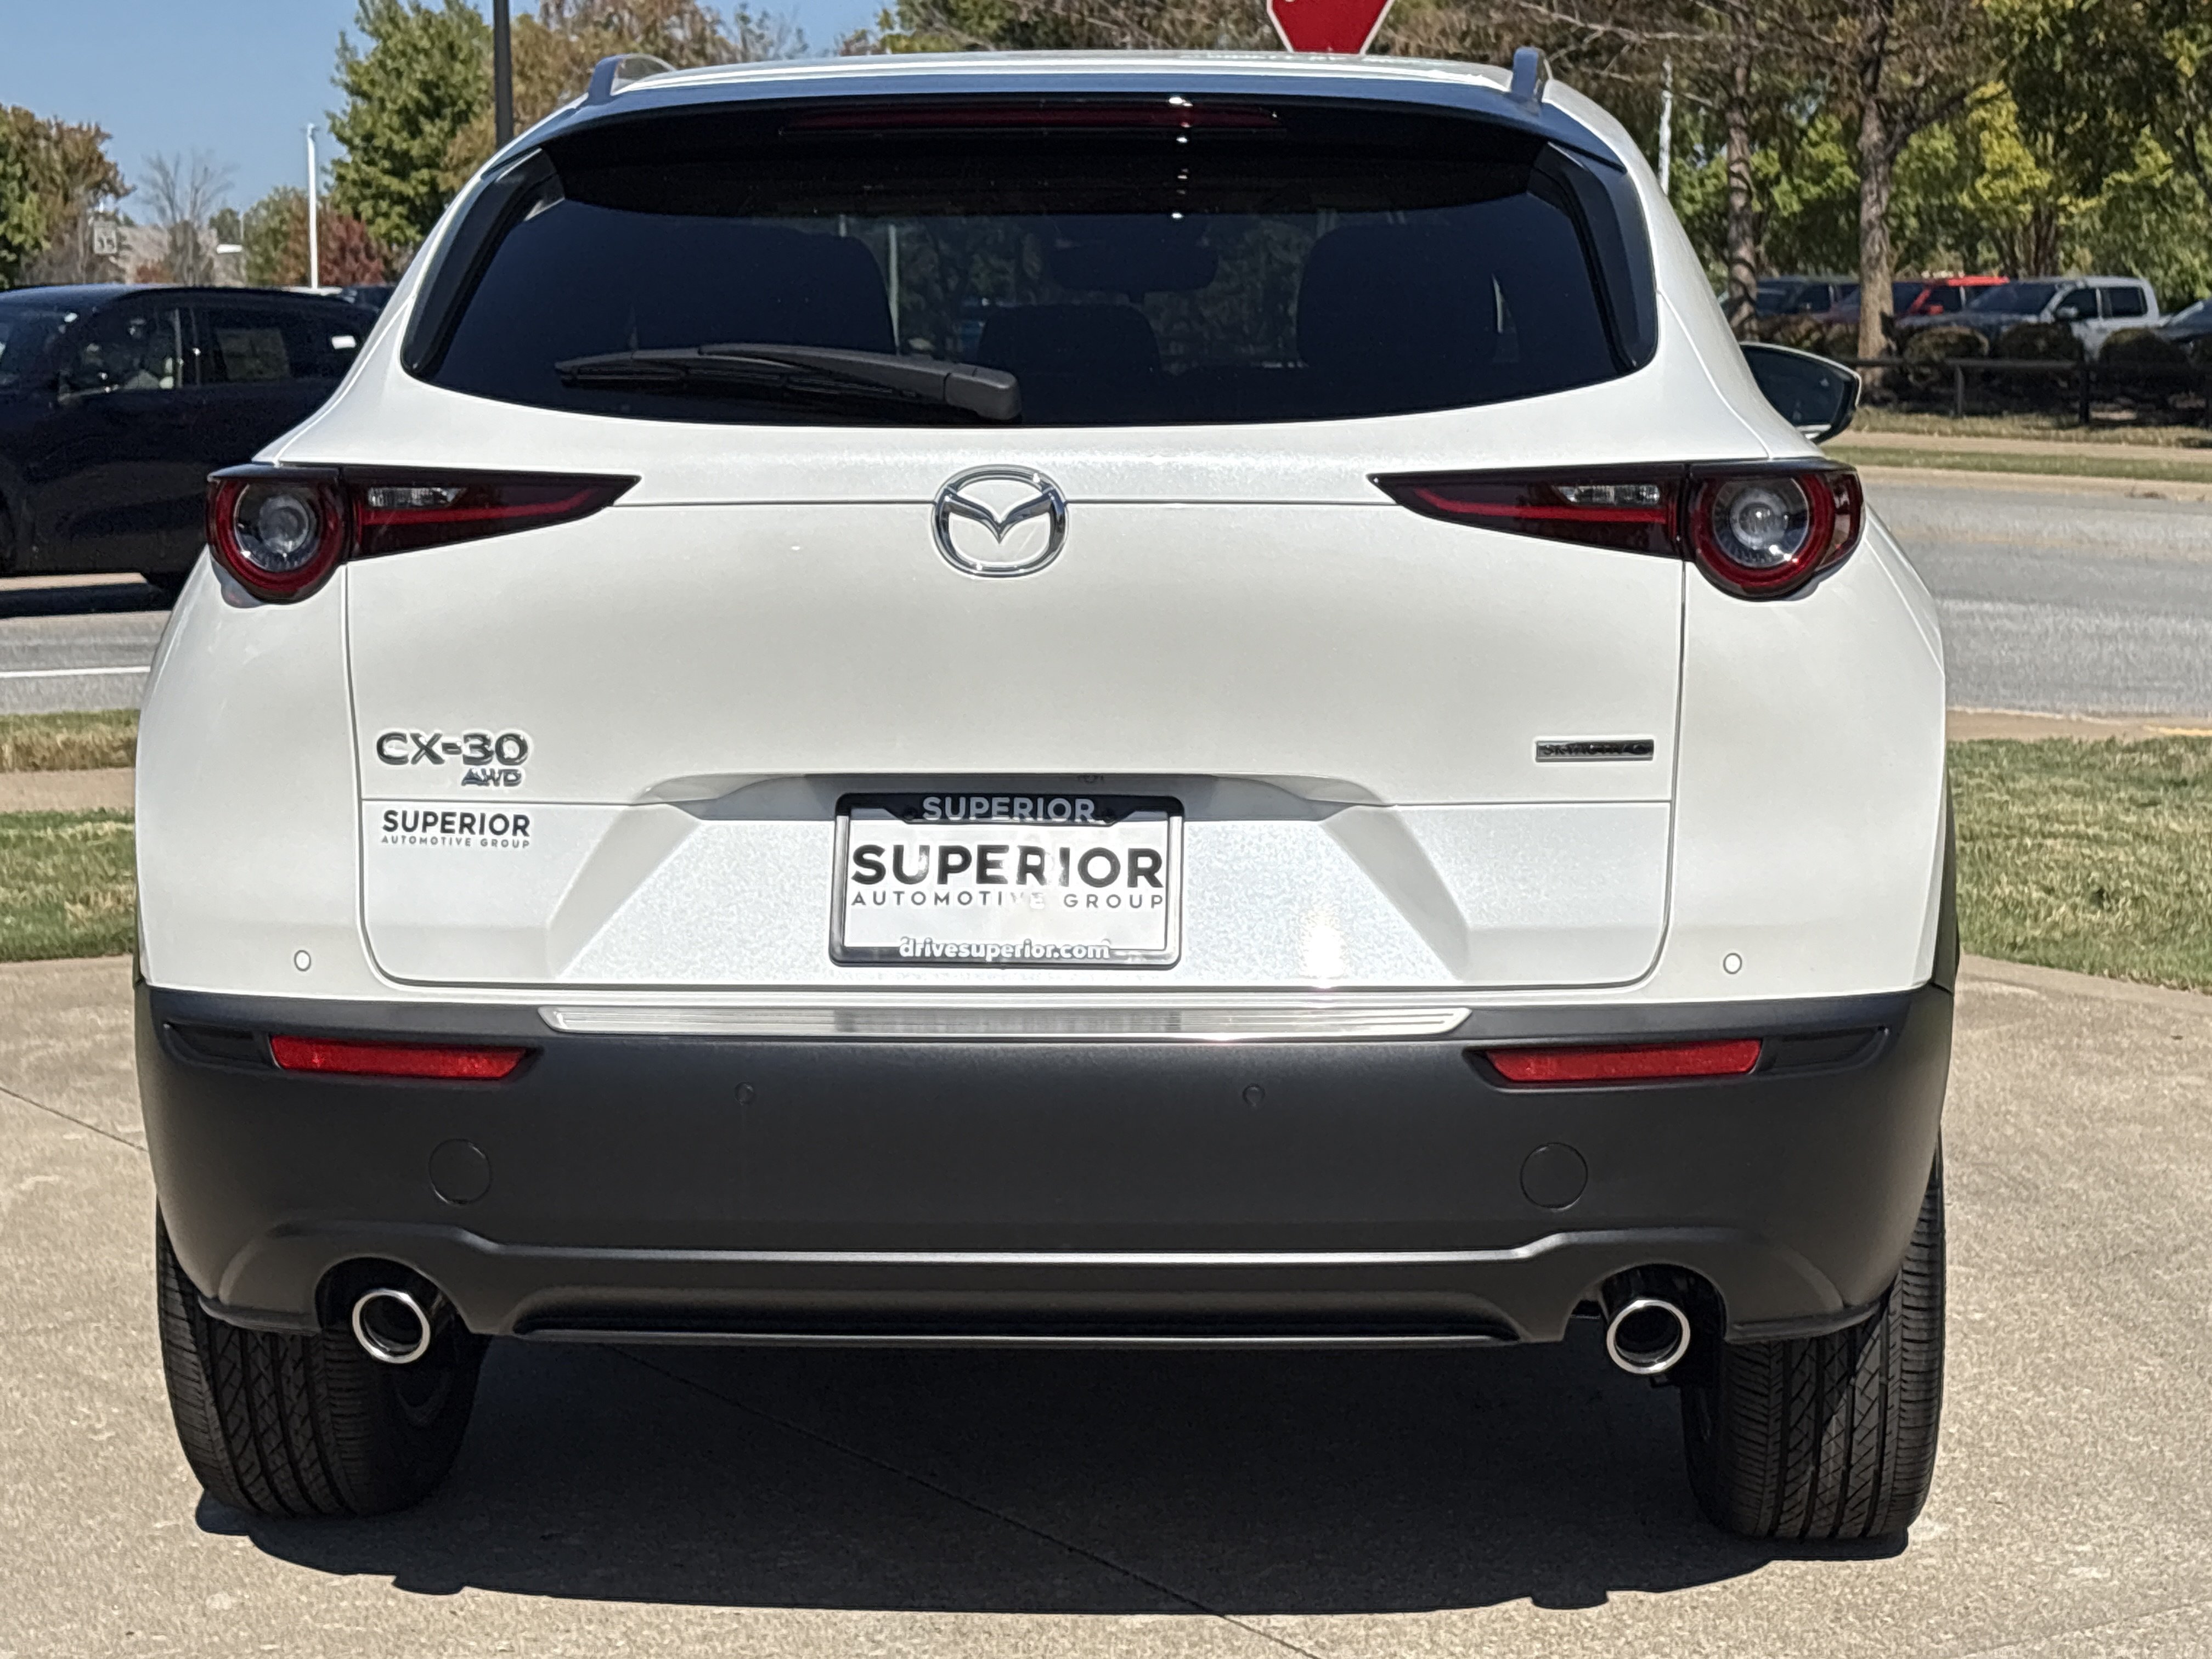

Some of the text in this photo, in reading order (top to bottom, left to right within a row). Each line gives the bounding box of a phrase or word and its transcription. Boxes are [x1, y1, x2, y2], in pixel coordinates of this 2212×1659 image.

[376, 732, 528, 765] CX-30
[461, 768, 523, 787] AWD
[923, 797, 1098, 822] SUPERIOR
[382, 810, 530, 837] SUPERIOR
[381, 835, 530, 849] AUTOMOTIVE GROUP
[851, 844, 1163, 888] SUPERIOR
[1063, 894, 1163, 909] GROUP
[899, 936, 1110, 962] drivesuperior.com
